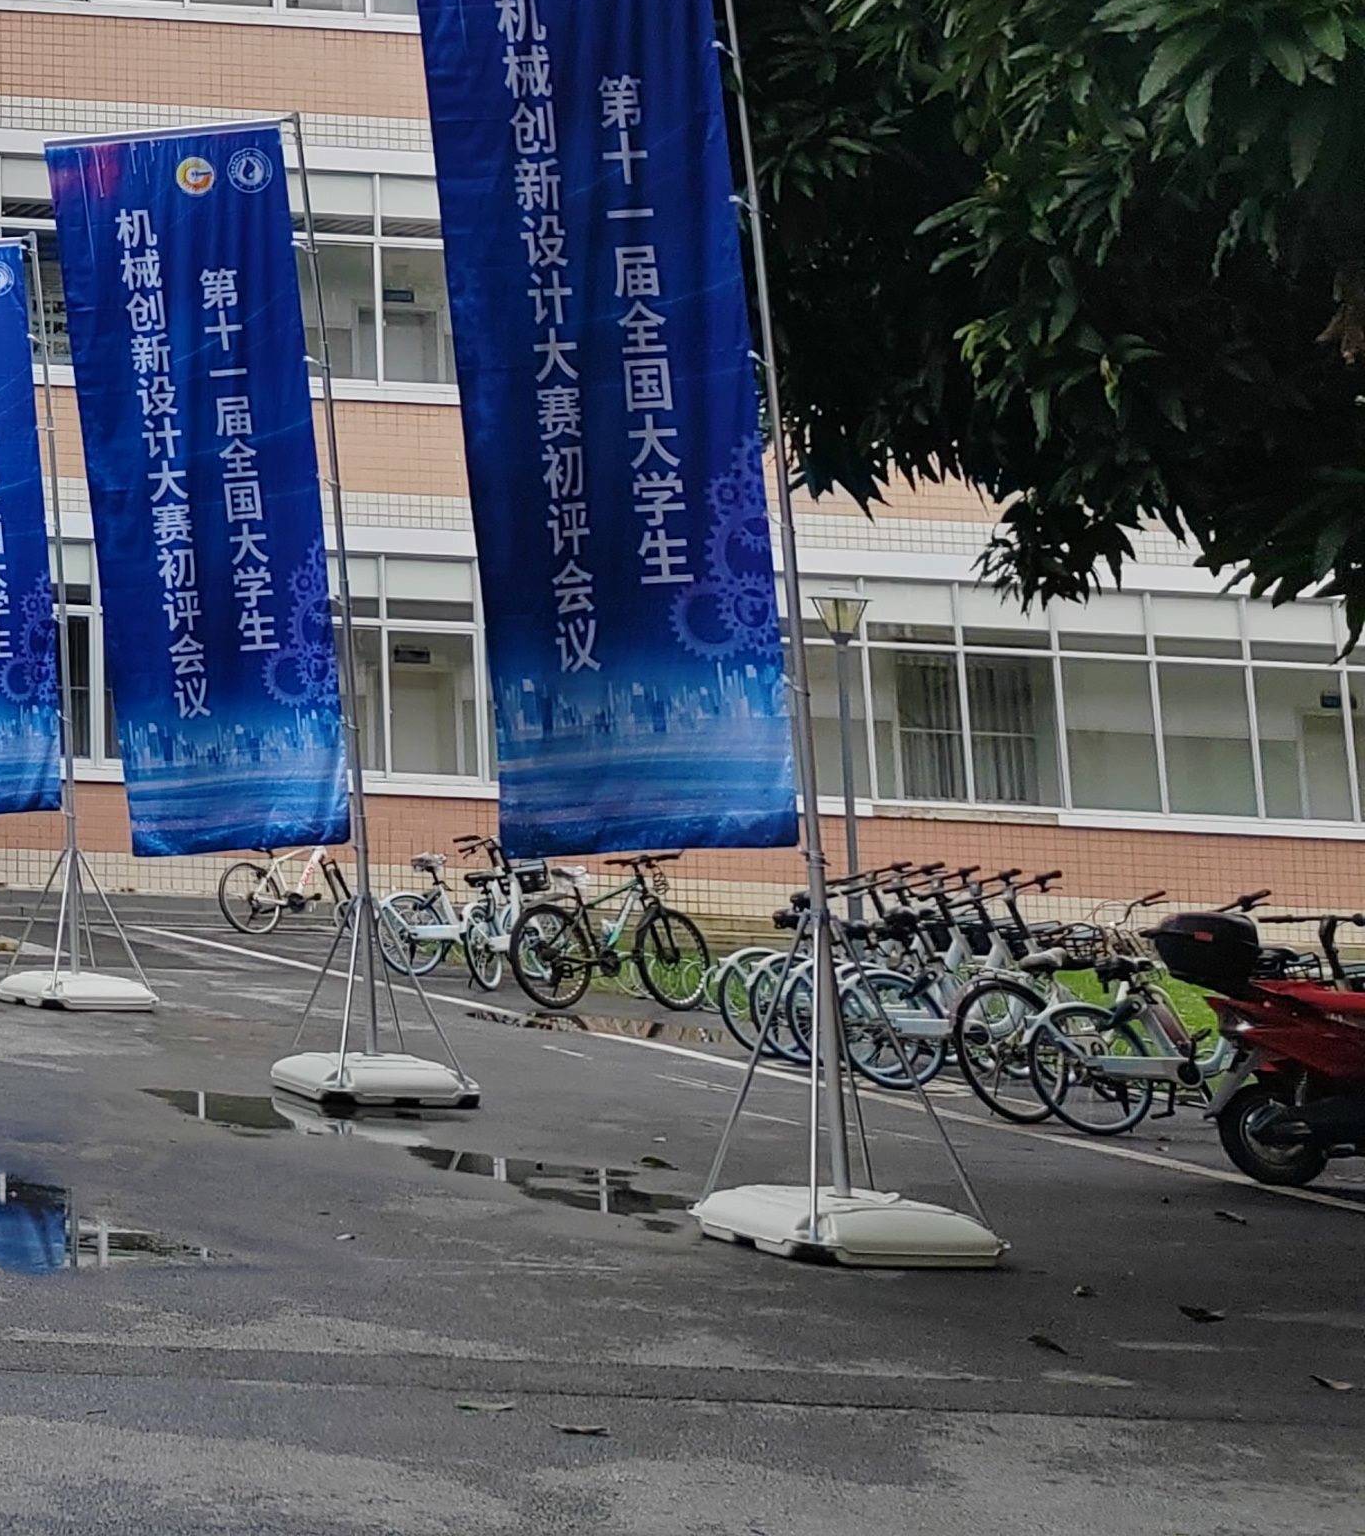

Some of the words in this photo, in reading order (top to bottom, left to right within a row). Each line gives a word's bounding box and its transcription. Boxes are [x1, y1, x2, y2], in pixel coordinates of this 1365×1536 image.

[114, 208, 211, 718] 机械创新设计大赛初评会议
[199, 268, 281, 652] 第十一届全国大学生
[598, 74, 695, 584] 第十一届全国大学生
